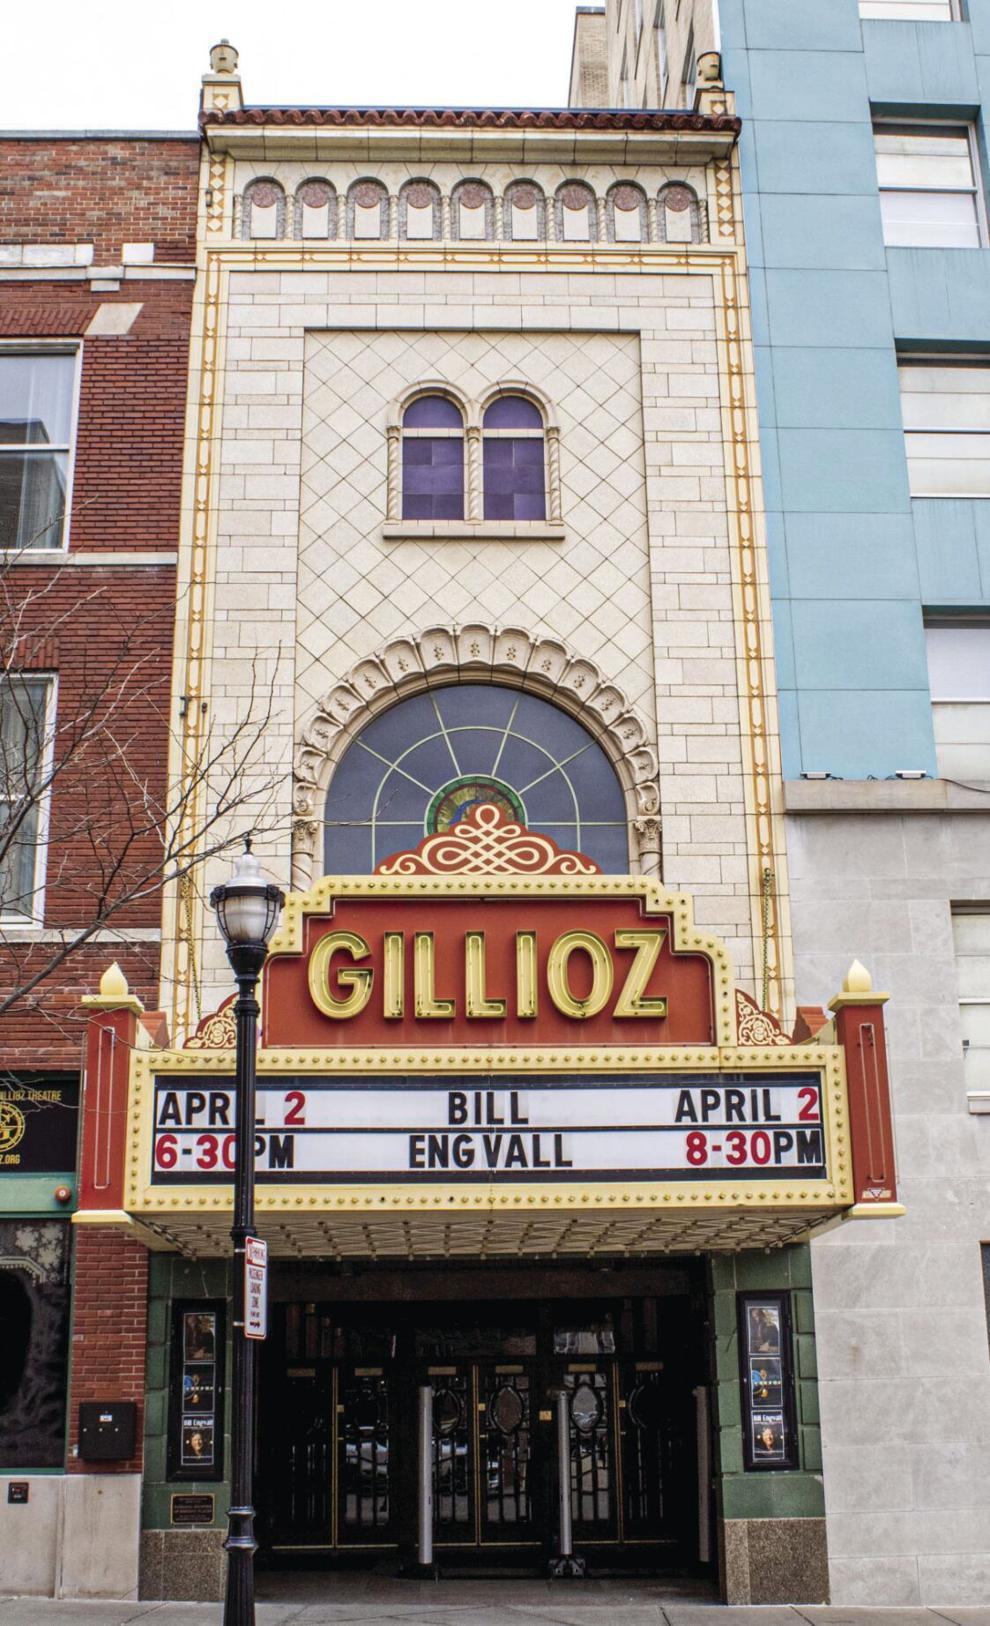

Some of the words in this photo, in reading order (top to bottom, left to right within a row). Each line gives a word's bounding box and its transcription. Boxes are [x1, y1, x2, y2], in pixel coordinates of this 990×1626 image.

[308, 928, 668, 1020] GILLIOZ
[158, 1092, 265, 1126] APR
[284, 1091, 306, 1126] 2
[448, 1091, 529, 1126] BILL
[674, 1088, 782, 1123] APRIL
[797, 1087, 820, 1122] 2
[409, 1133, 573, 1169] ENGVALL
